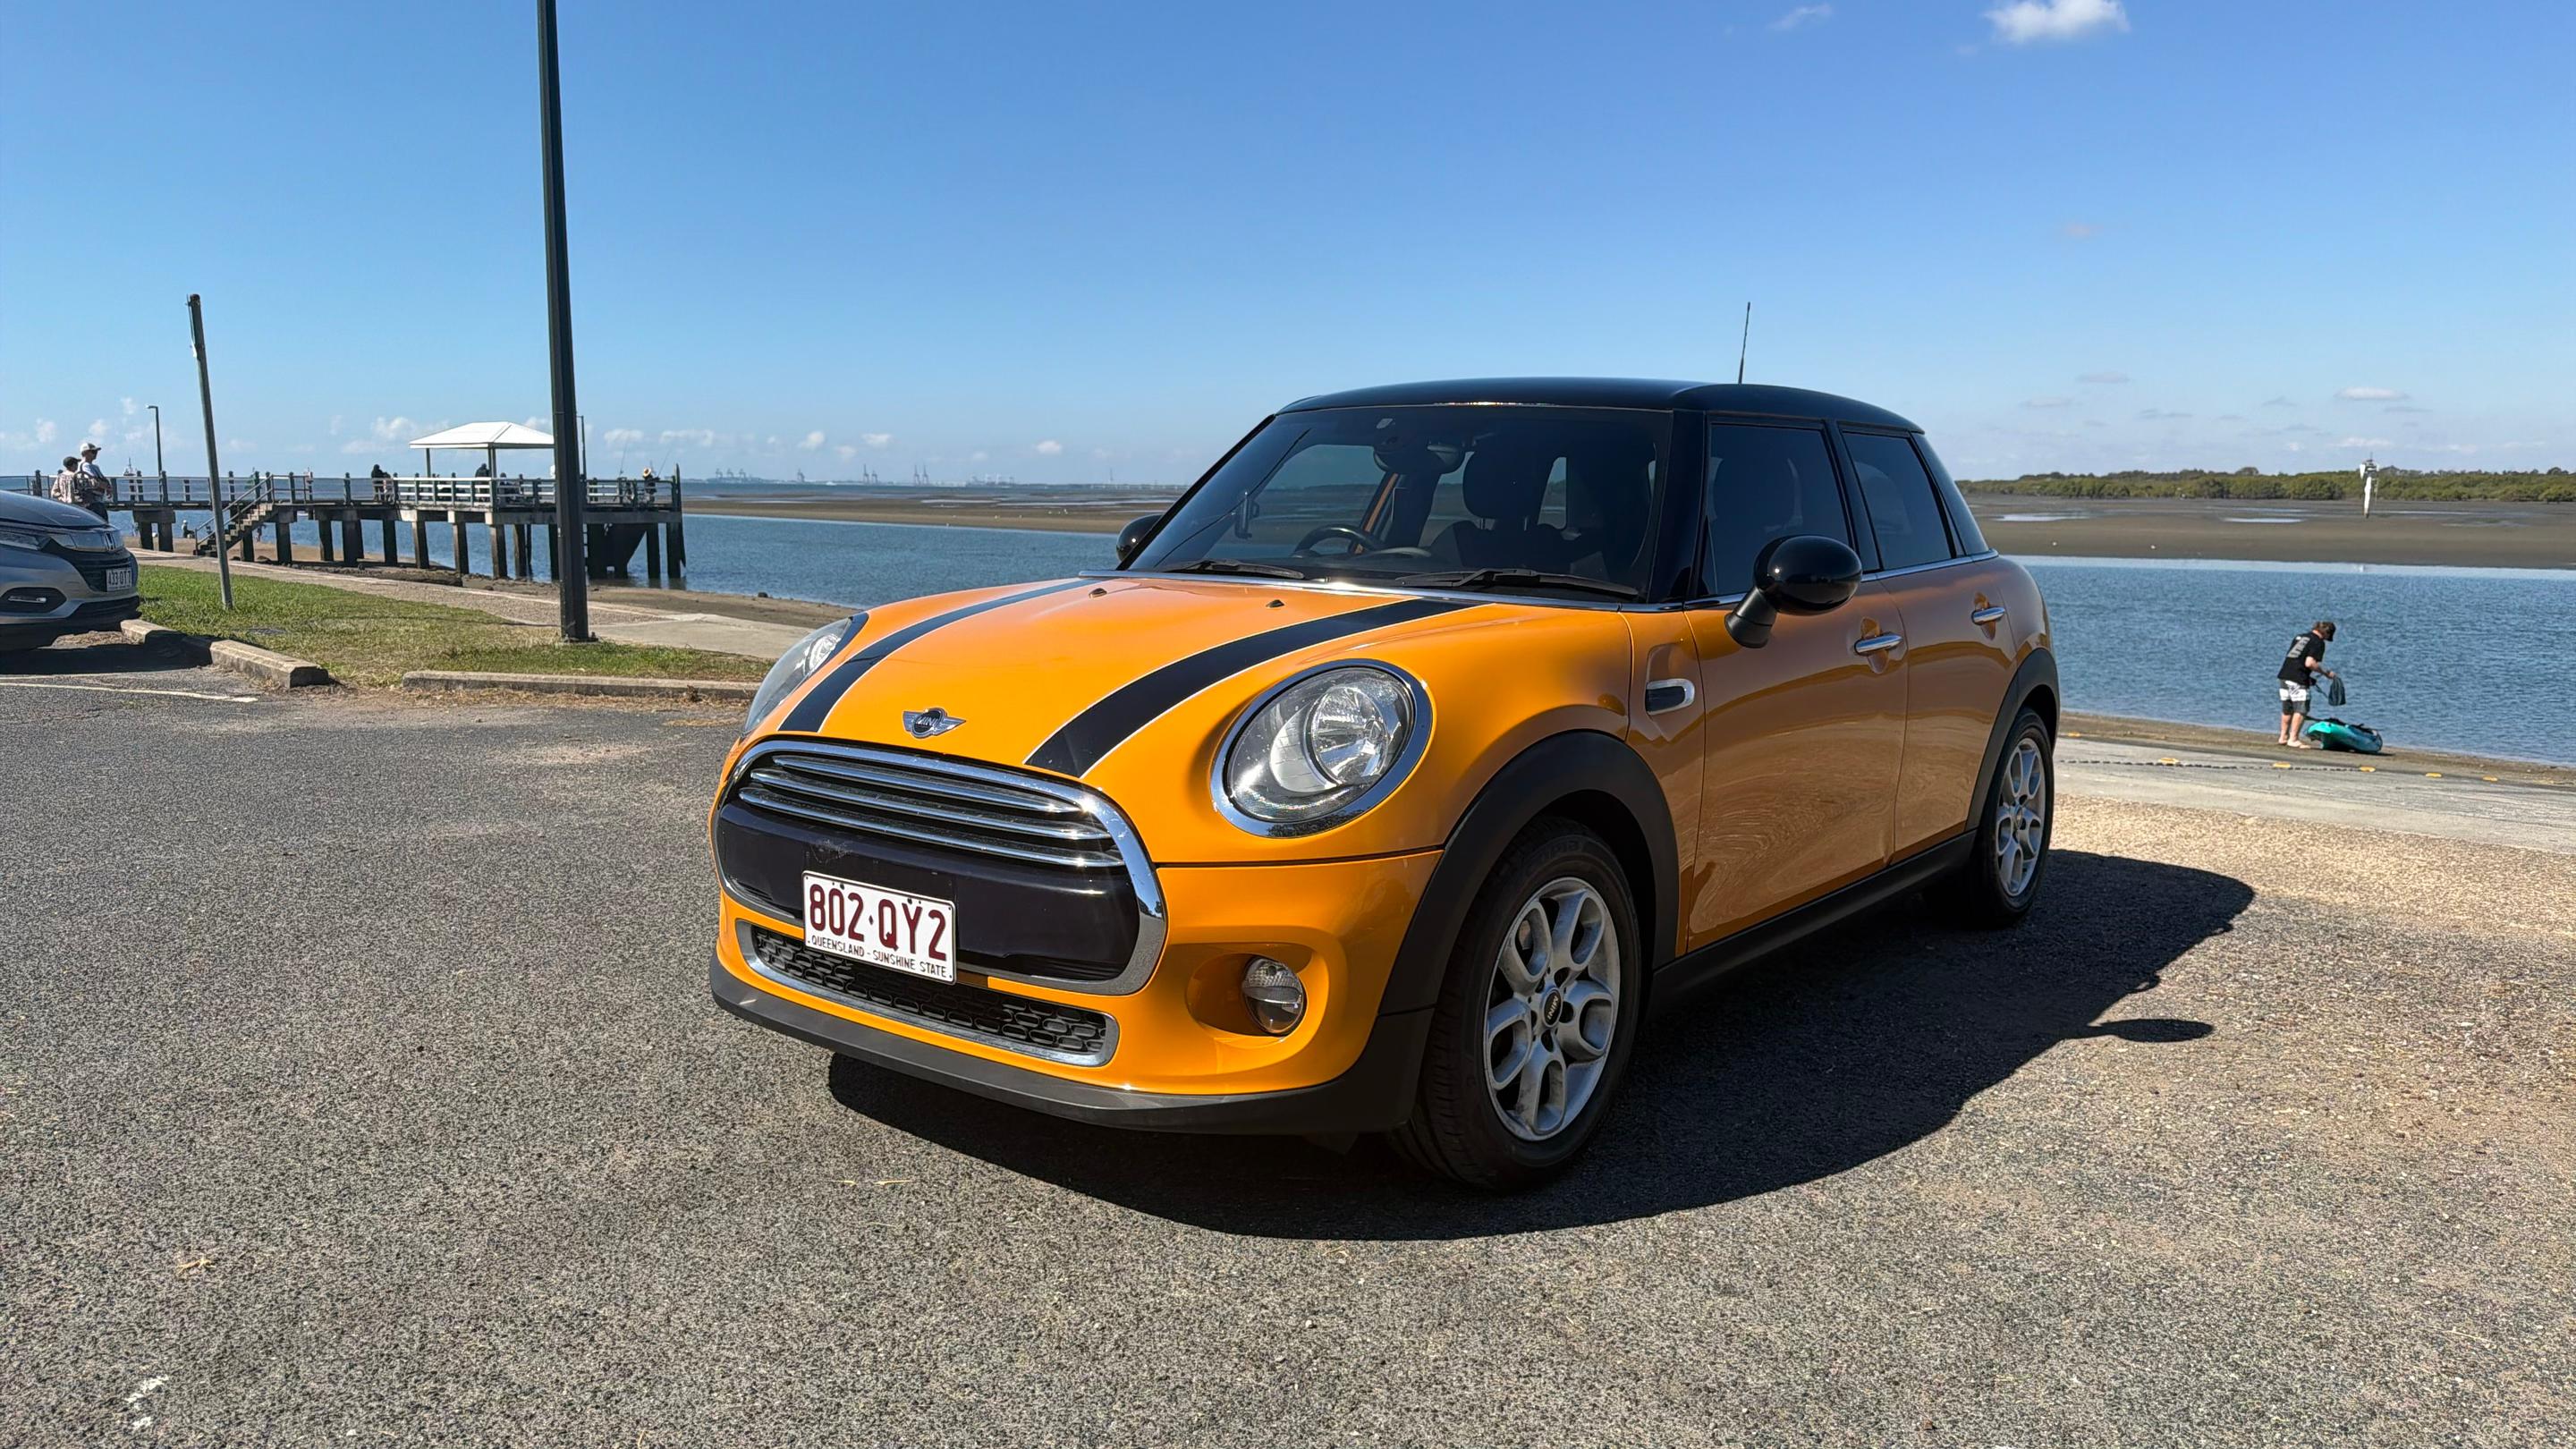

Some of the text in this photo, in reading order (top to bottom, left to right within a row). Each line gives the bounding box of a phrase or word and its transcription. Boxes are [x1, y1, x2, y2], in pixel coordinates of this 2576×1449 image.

[811, 935, 865, 957] QUEENSLAND
[872, 949, 916, 970] SUNSHINE
[919, 961, 947, 978] STATE
[1546, 995, 1559, 1020] MINI
